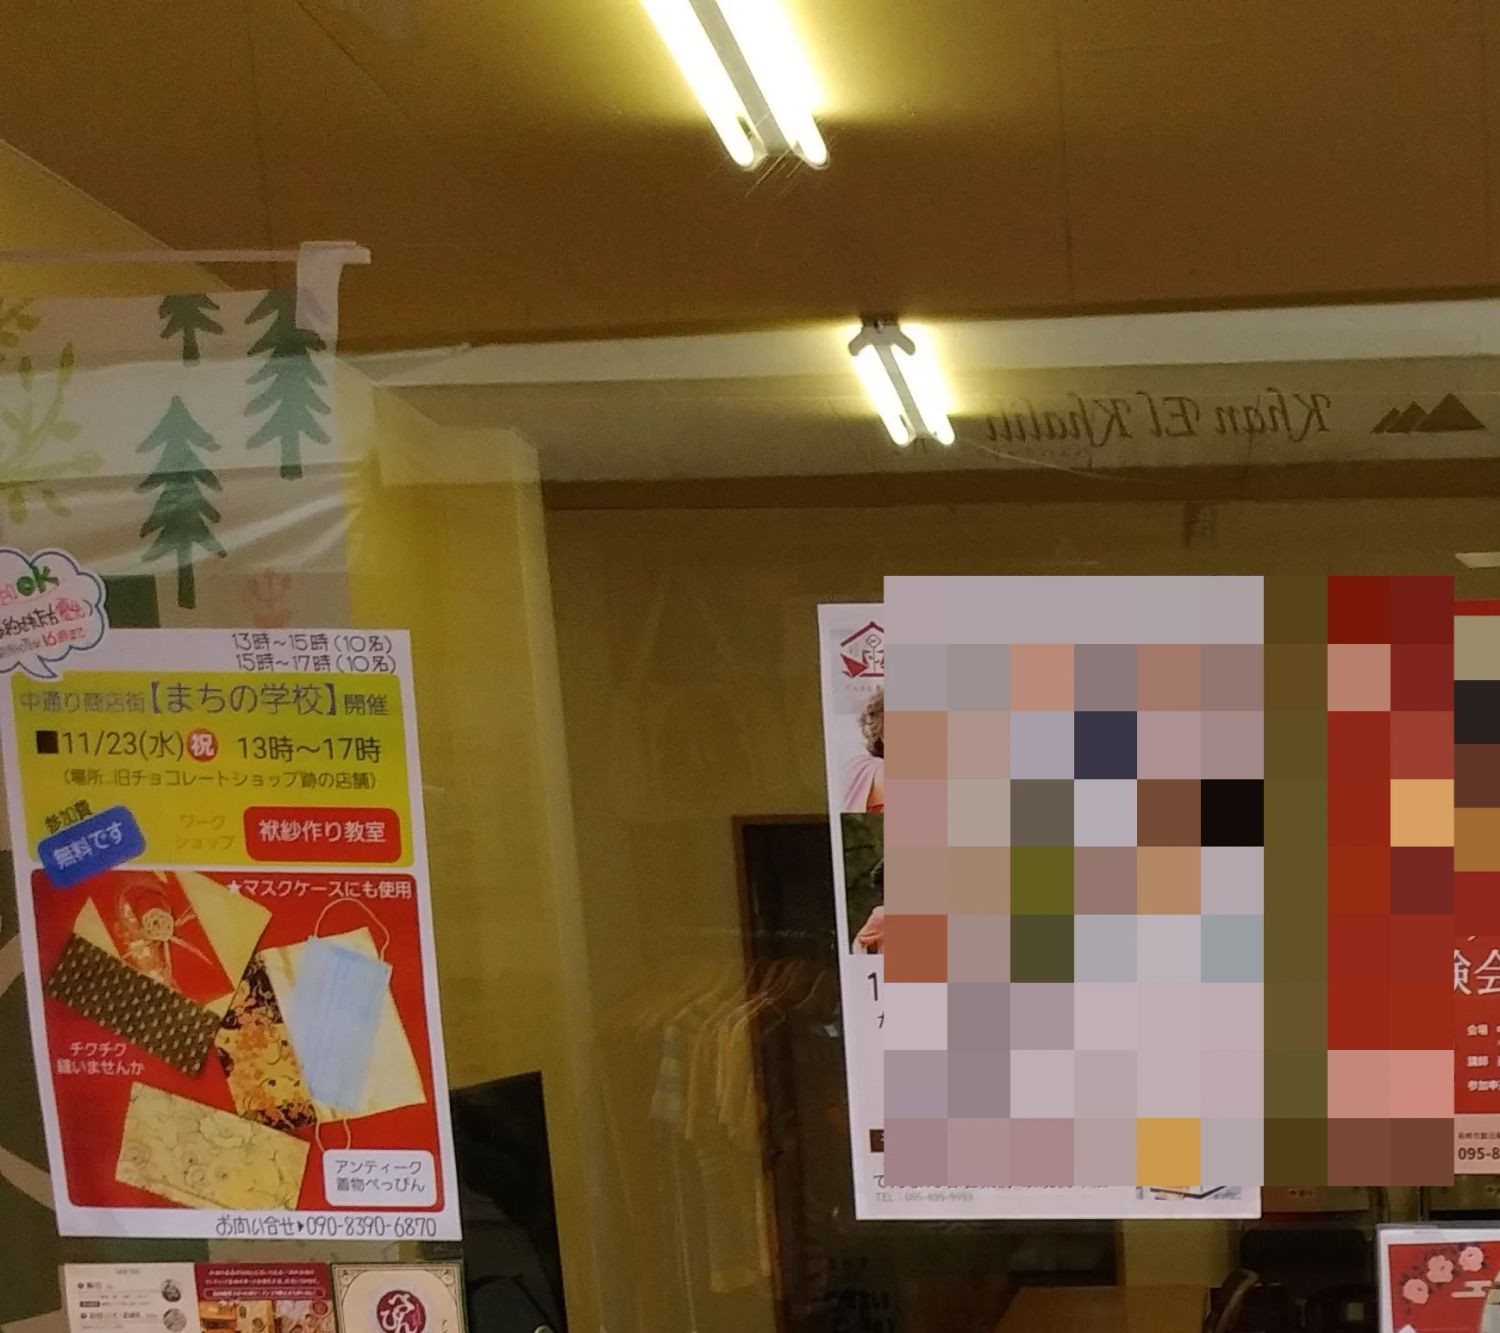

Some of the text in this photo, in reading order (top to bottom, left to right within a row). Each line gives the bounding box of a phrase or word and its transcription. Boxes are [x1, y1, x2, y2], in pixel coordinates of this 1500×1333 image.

[52, 820, 124, 870] 無料です
[69, 1041, 128, 1058] チクチク
[55, 1058, 145, 1076] 縫いませんか
[334, 1159, 423, 1177] アンティーク
